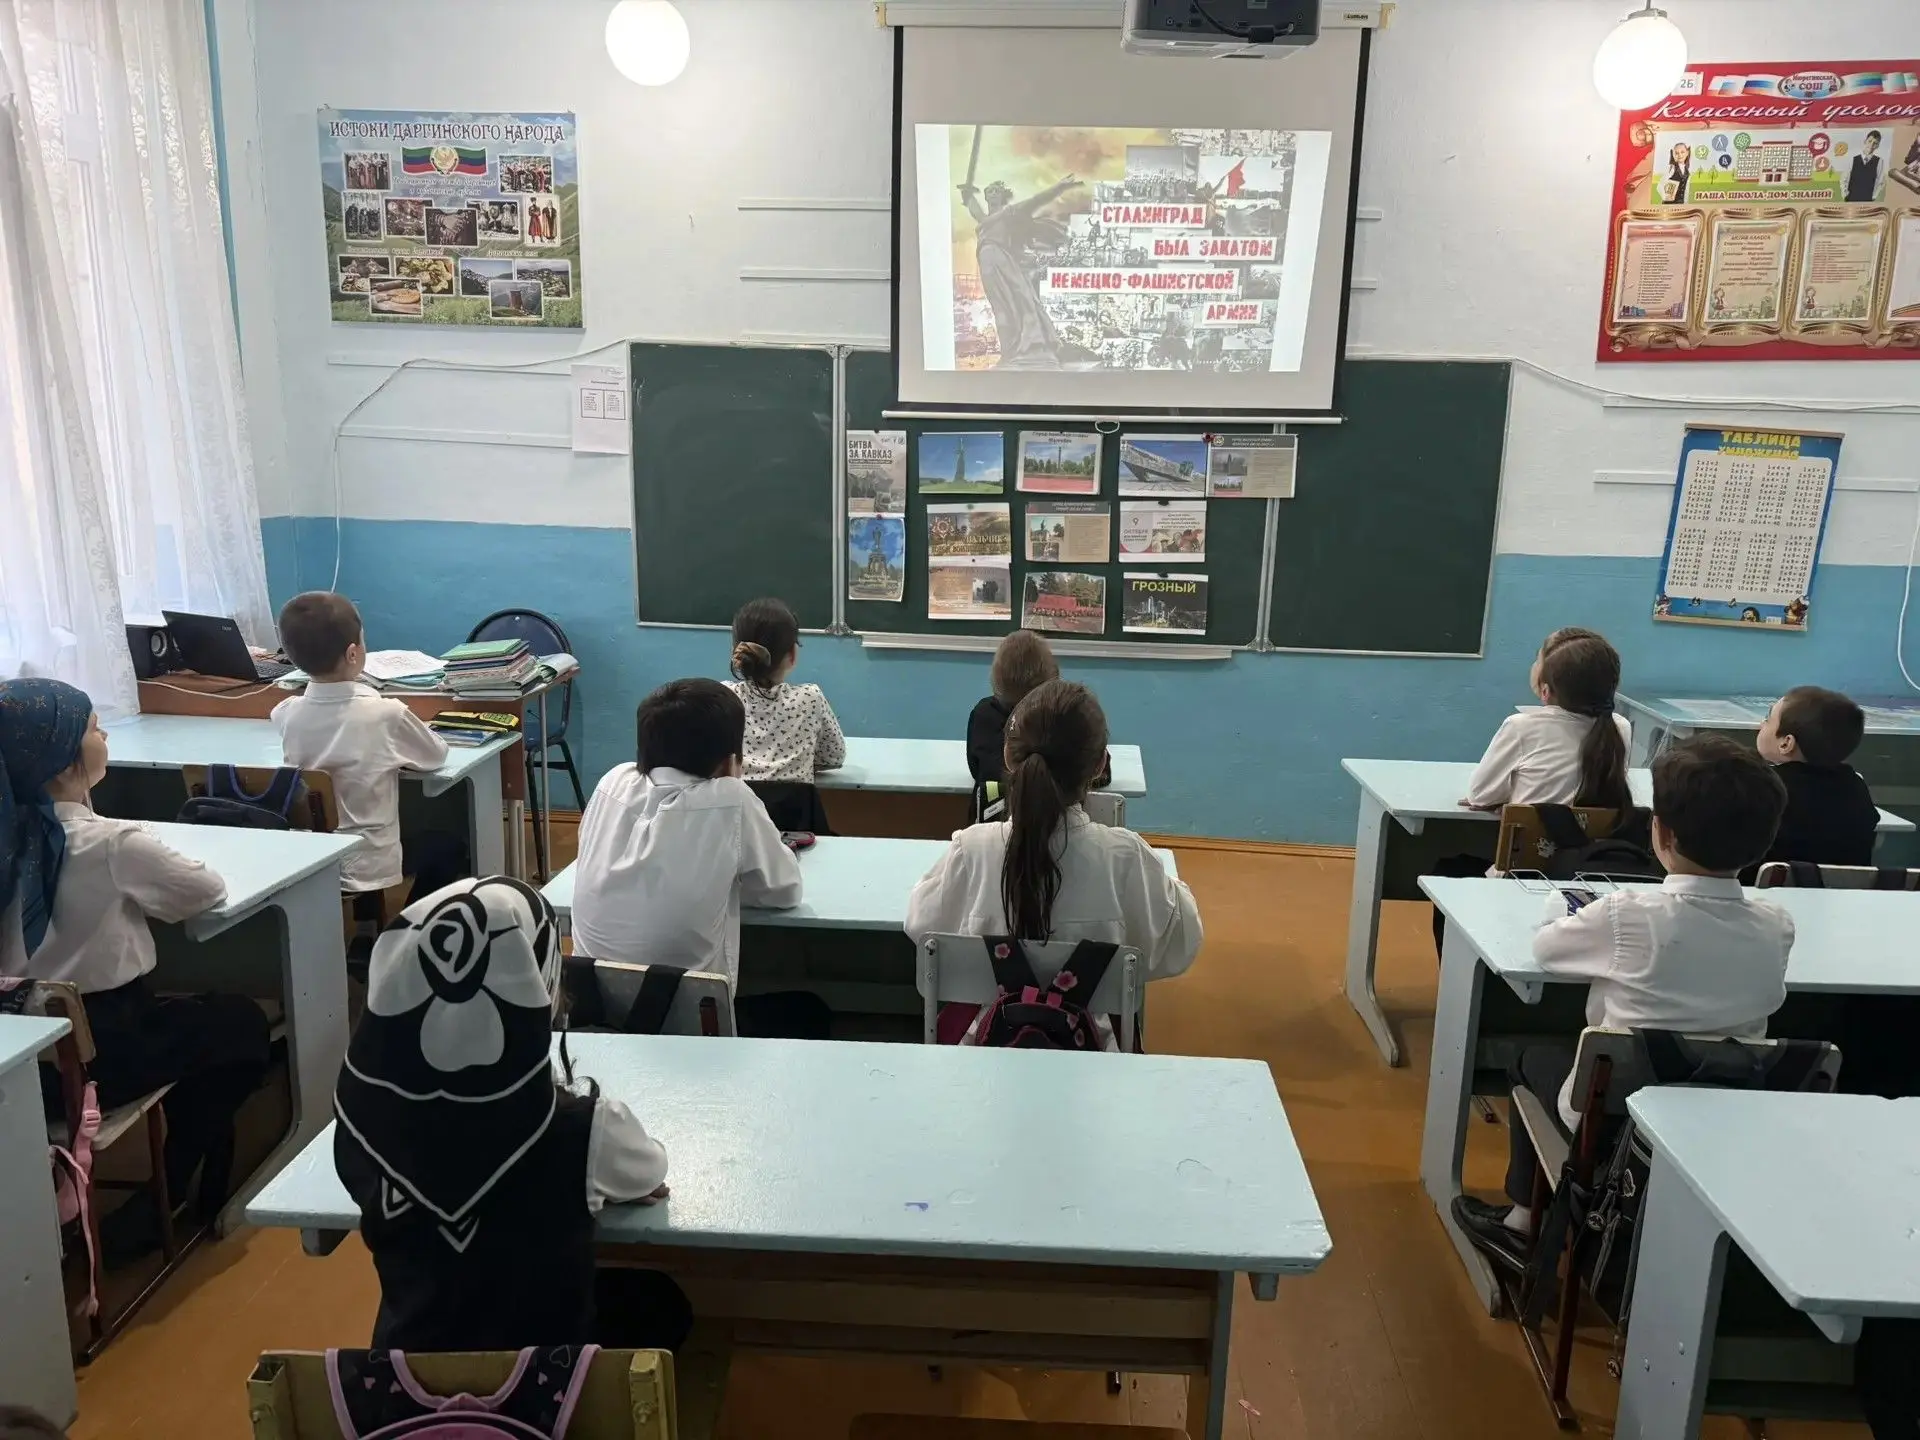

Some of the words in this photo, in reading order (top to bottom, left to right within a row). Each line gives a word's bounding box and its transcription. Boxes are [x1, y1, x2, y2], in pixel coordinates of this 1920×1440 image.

[1799, 82, 1824, 90] СОШ
[1651, 100, 1813, 119] Классный
[1822, 104, 1920, 121] уголок
[330, 121, 388, 138] ИСТОКИ
[393, 123, 500, 141] ДАРГИНСКОГО
[504, 125, 565, 143] НАРОДА
[1102, 206, 1203, 225] СТАЛИНГРАД
[1154, 239, 1190, 256] БЫЛ
[1200, 239, 1273, 257] ЗАКАТОМ
[1051, 271, 1235, 290] НЕМЕЦКО-ФАШИСТСКОЙ
[1206, 304, 1258, 320] АРМИИ
[848, 440, 872, 449] БИТВА
[1721, 431, 1800, 449] ТАБЛИЦА
[849, 449, 859, 458] ЗА
[861, 449, 892, 459] КАВКАЗ
[1132, 581, 1197, 593] ГРОЗНЫЙ
